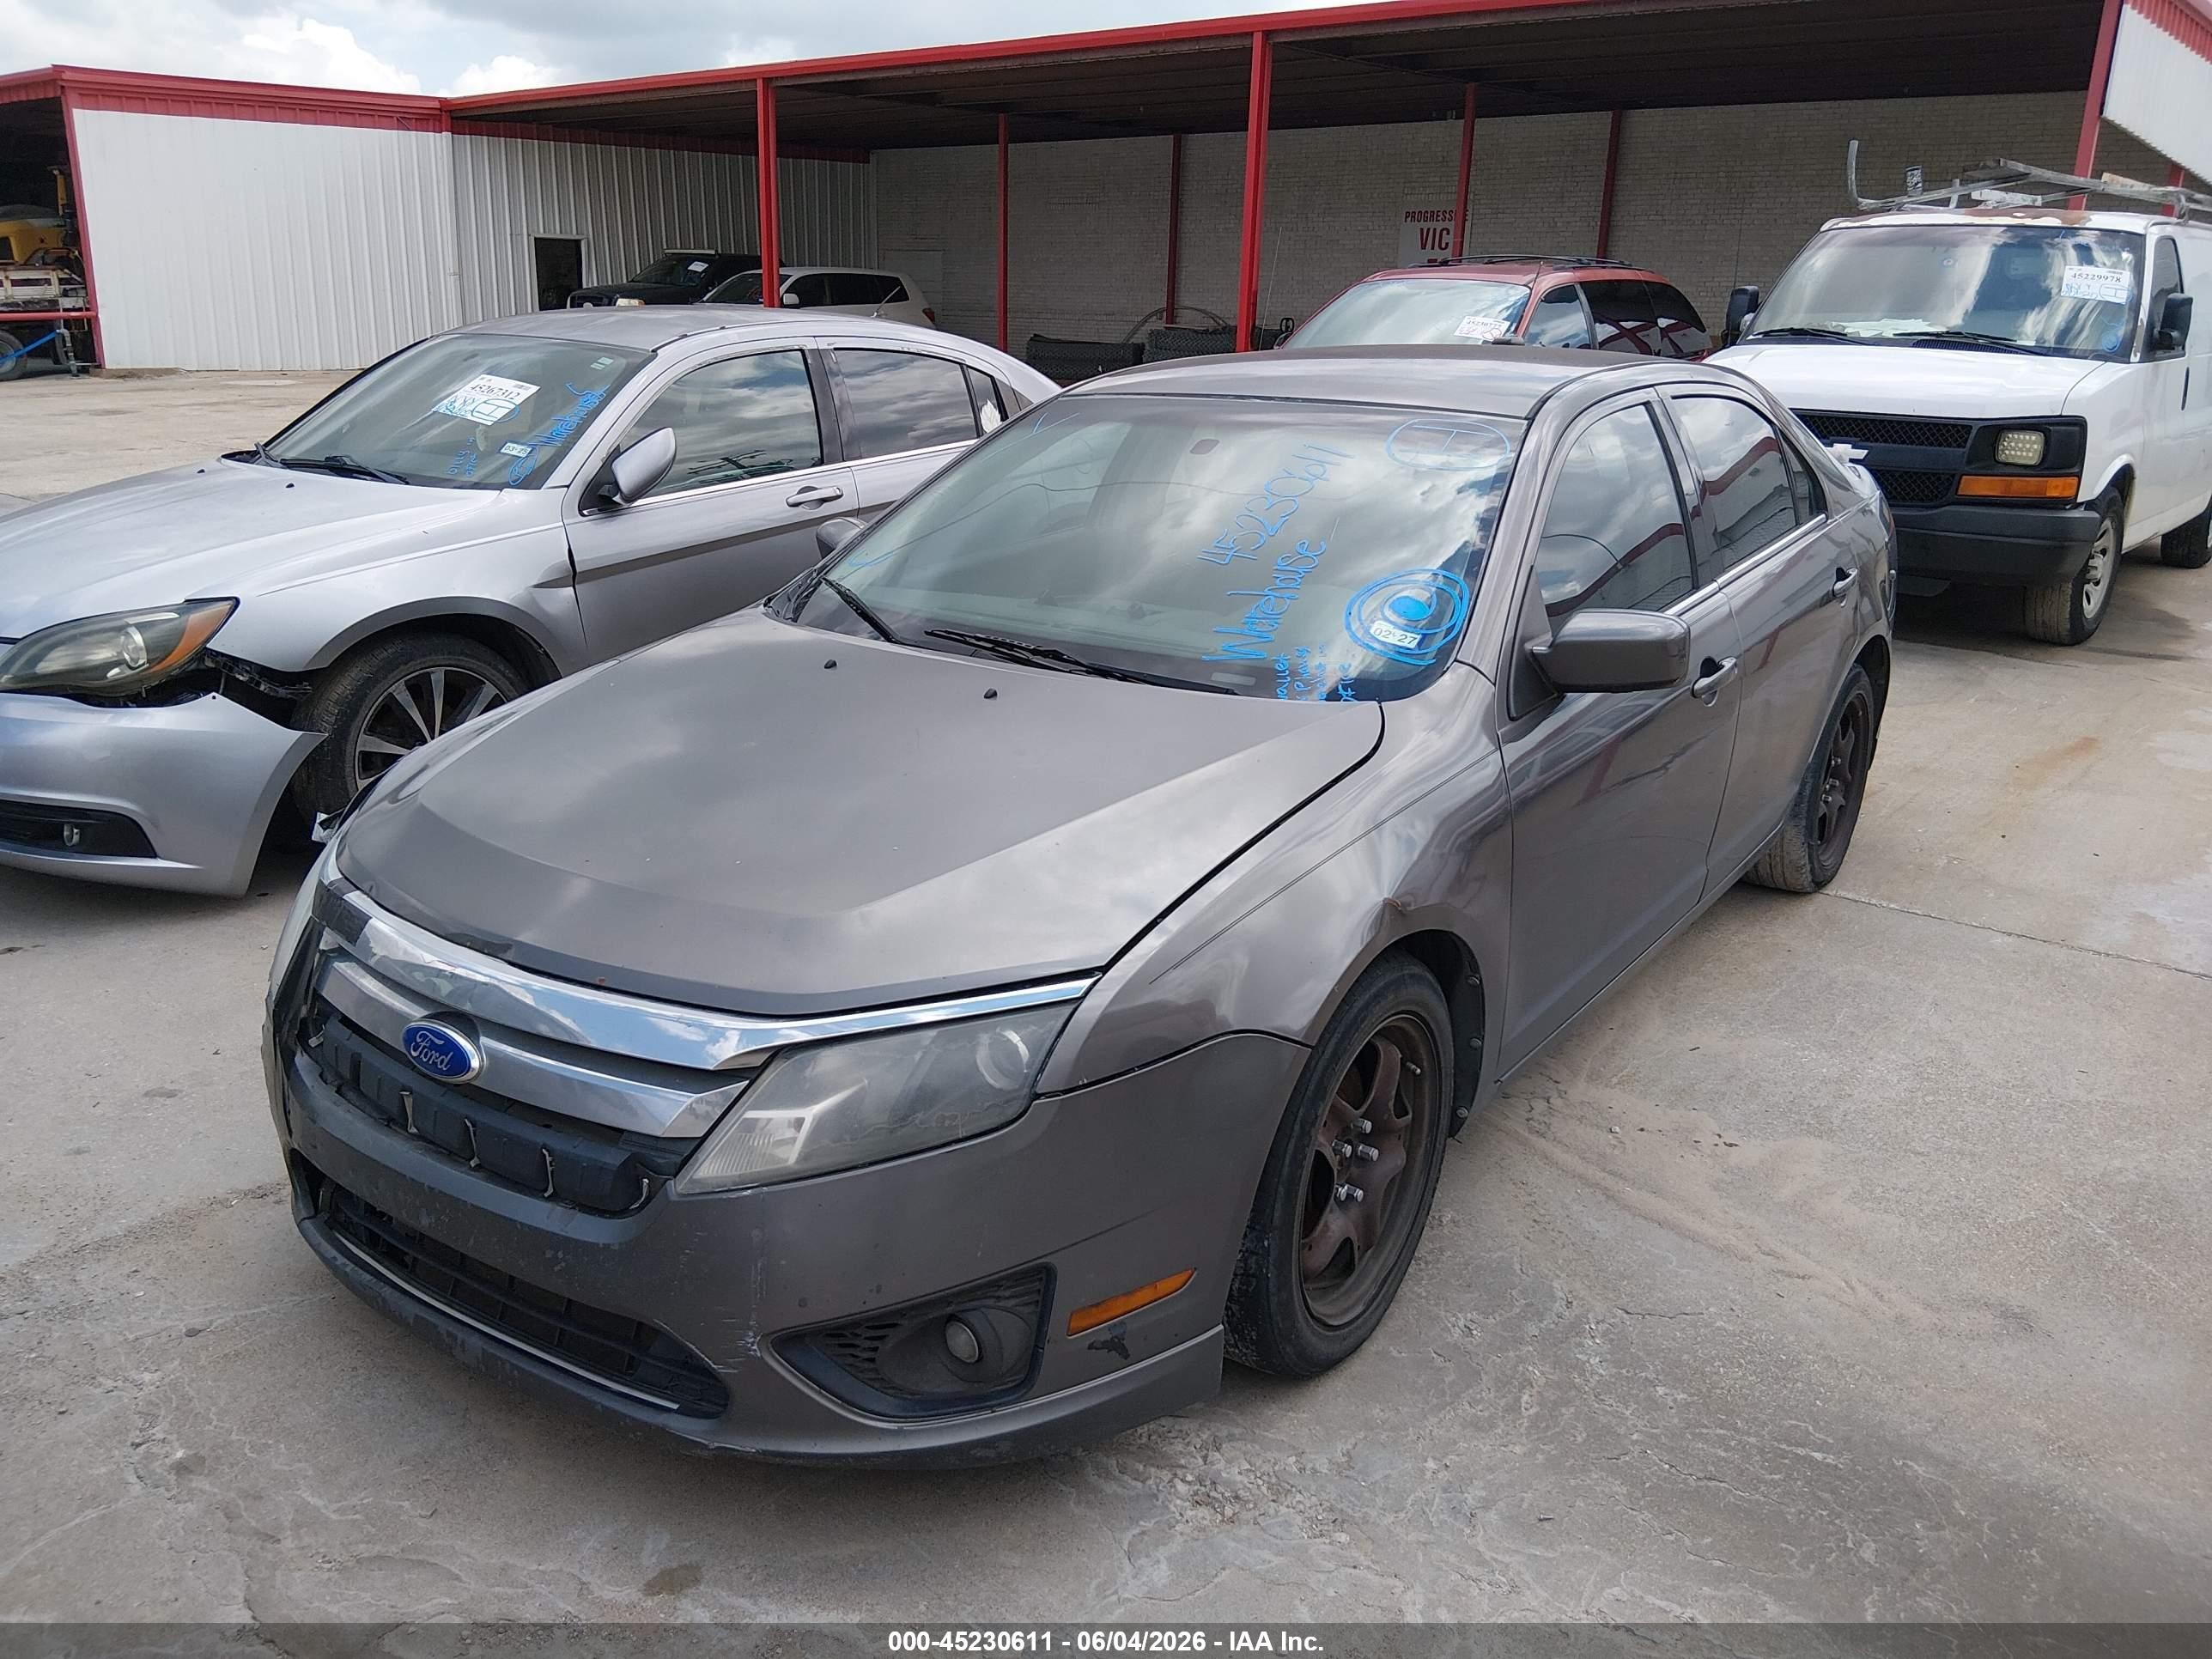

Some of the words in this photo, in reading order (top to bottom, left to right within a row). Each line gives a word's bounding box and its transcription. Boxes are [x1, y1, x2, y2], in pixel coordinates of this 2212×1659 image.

[1404, 210, 1469, 223] PROGRESSIE
[1419, 227, 1450, 251] VIC
[1201, 538, 1328, 661] Warehouse
[410, 1030, 454, 1071] Ford
